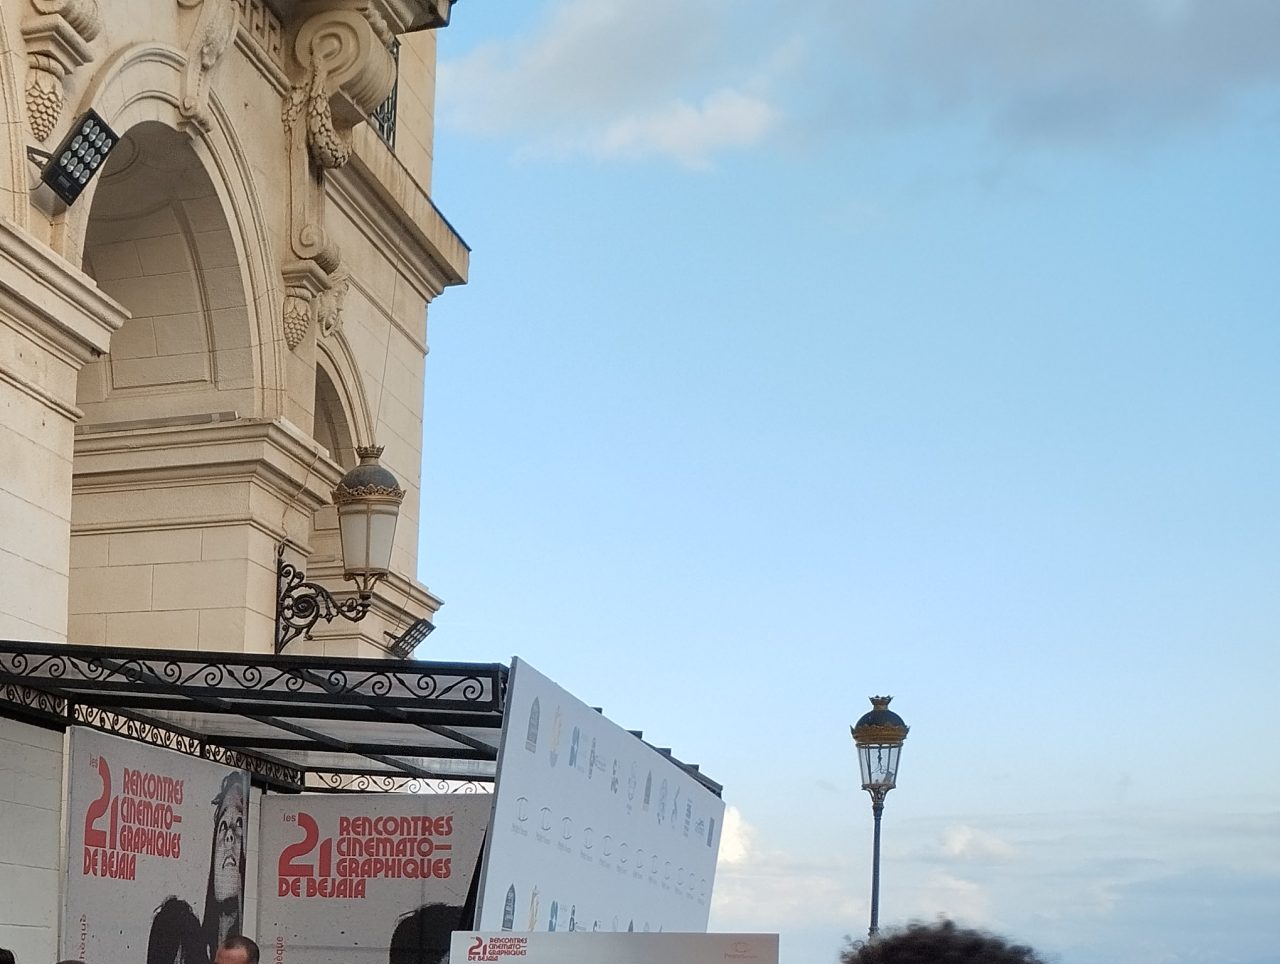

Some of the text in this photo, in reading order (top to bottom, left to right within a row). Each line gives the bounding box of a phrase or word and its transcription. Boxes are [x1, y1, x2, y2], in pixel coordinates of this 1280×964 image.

[85, 755, 119, 850] 21
[123, 767, 184, 805] RENCONTRES
[120, 824, 181, 859] GRAPHIQUES
[339, 816, 453, 836] RENCONTRES
[278, 812, 332, 877] 21
[83, 846, 136, 881] DE BEJAIA
[336, 857, 451, 879] GRAPHIQUES
[278, 877, 366, 898] DE BEJAIA
[468, 936, 487, 955] 21
